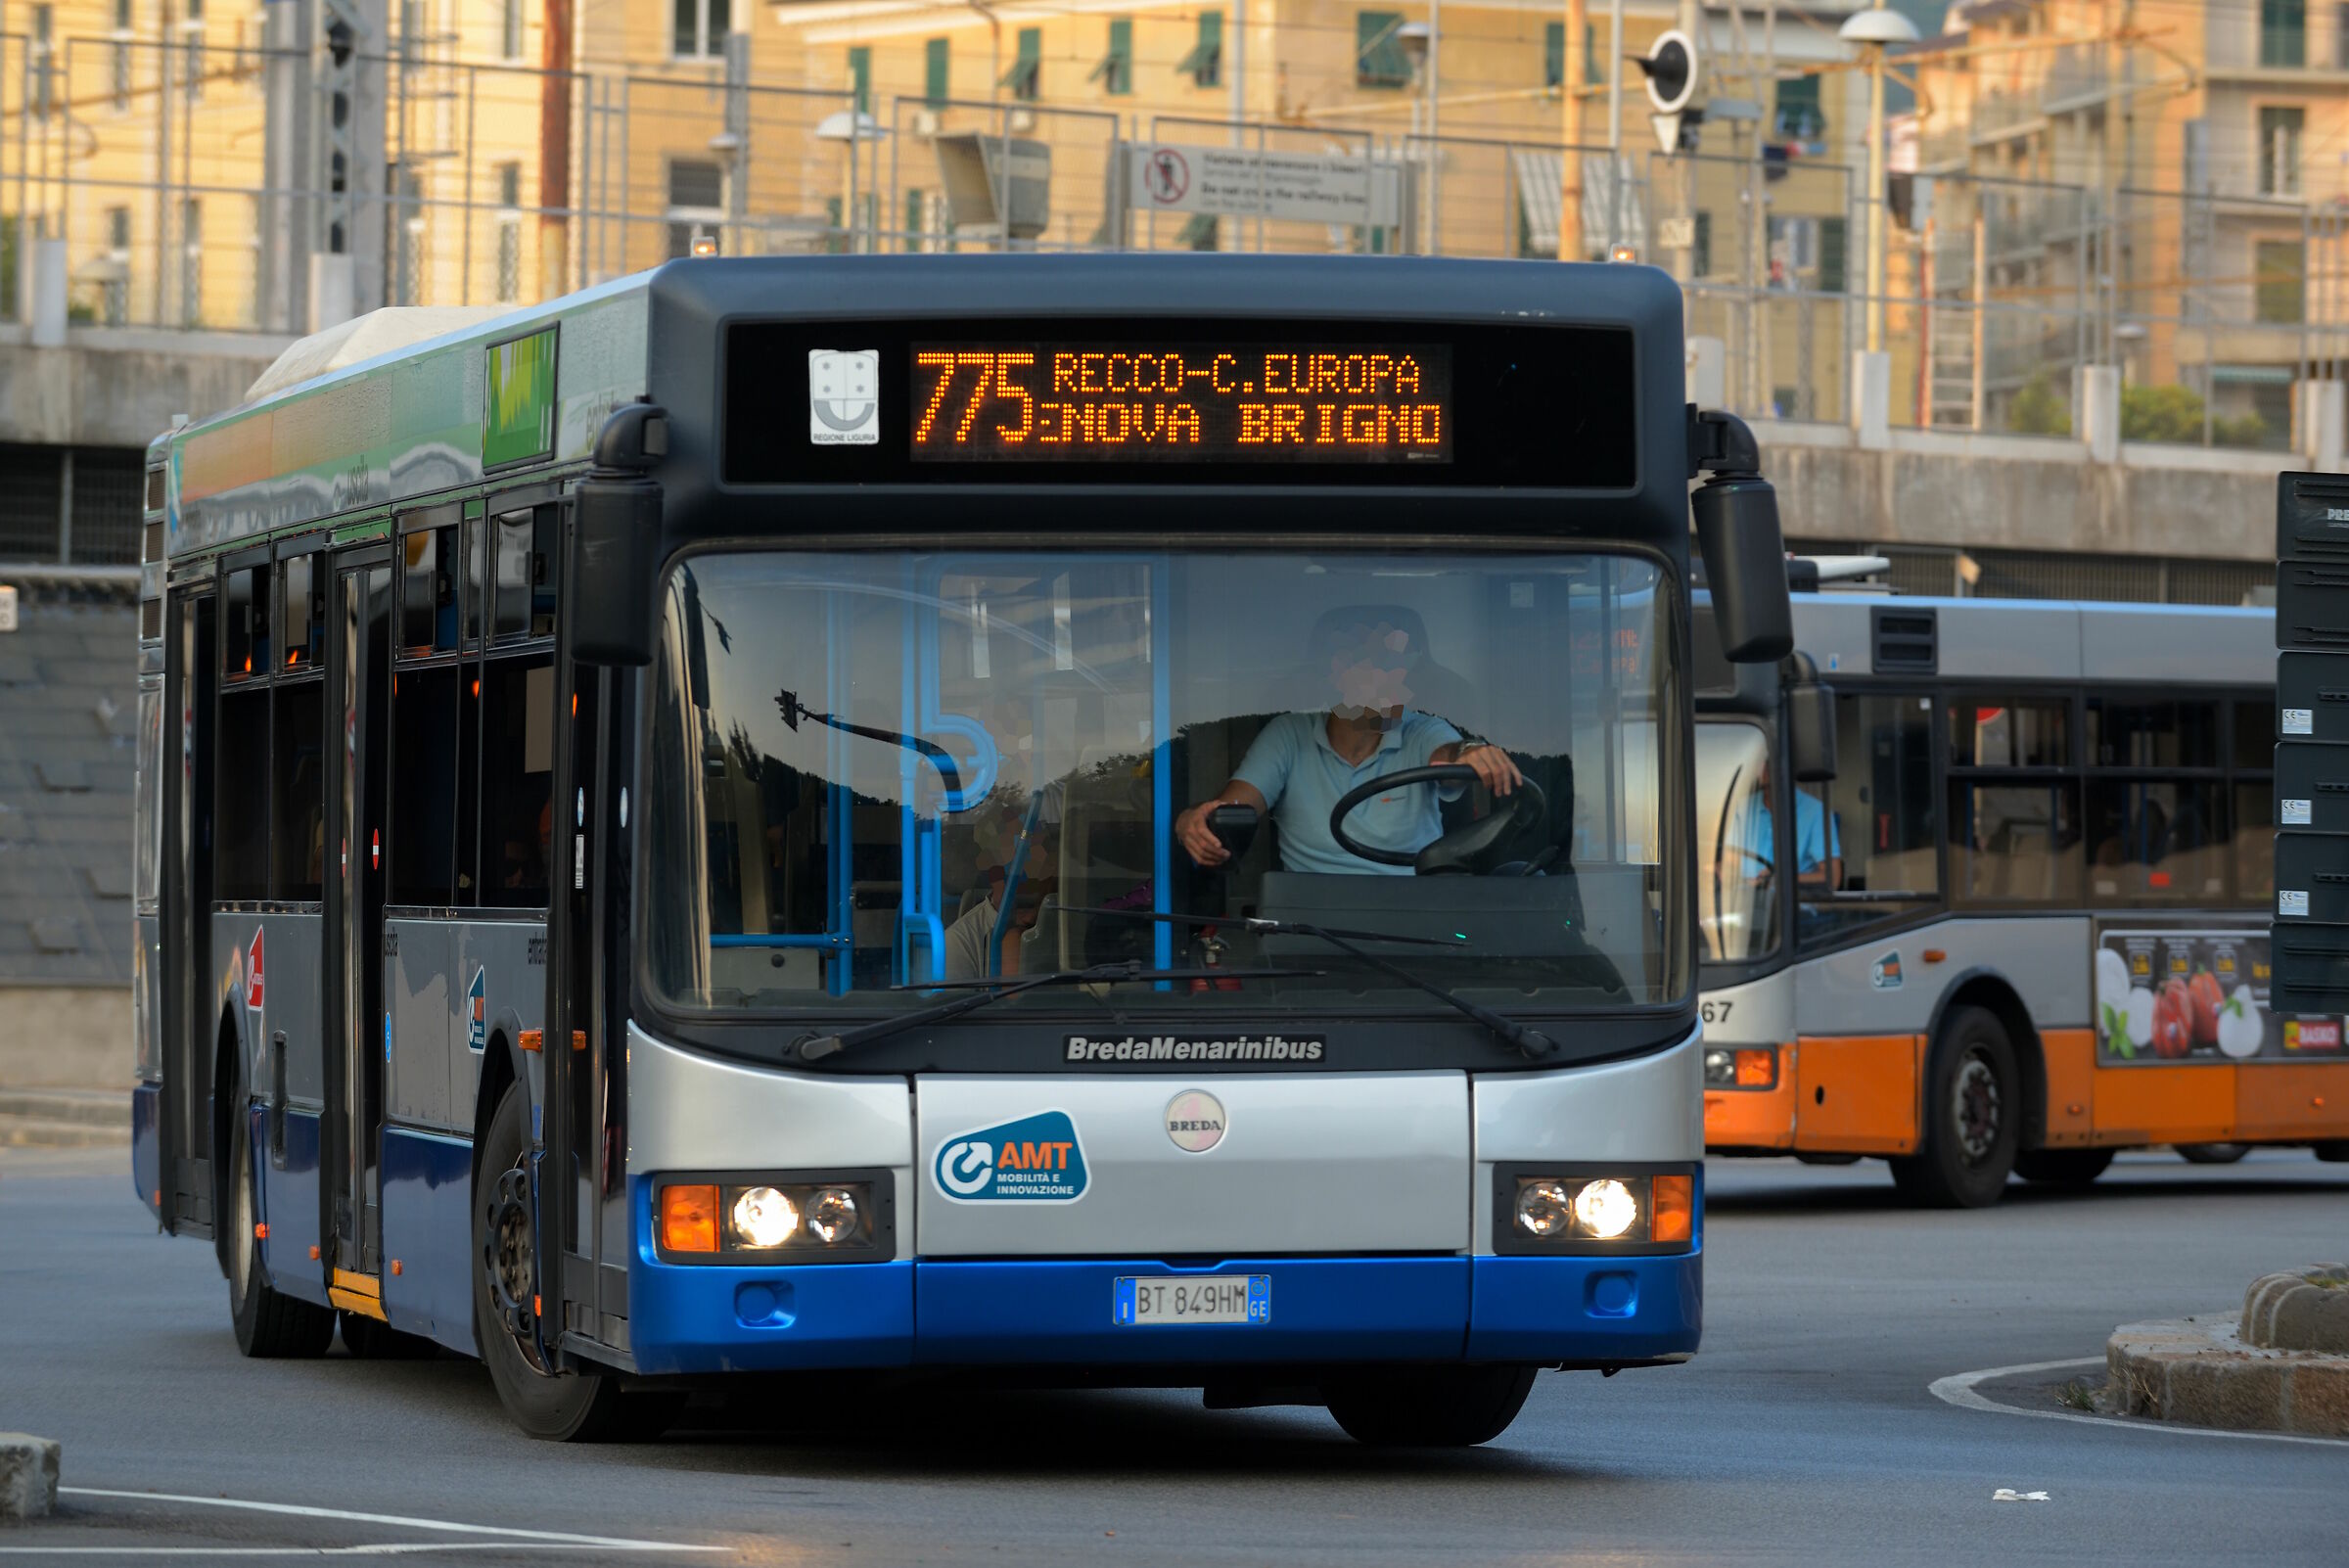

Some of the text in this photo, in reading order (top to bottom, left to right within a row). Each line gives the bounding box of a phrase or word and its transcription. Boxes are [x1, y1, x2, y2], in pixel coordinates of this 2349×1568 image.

[1053, 352, 1420, 394] RECCO-C.EUROPA
[916, 352, 1035, 442] 775
[813, 433, 876, 442] REGIONE LIGURIA
[1067, 1037, 1323, 1061] BredaMenarinibus
[1169, 1120, 1222, 1132] BREDA
[997, 1141, 1073, 1170] AMT
[996, 1172, 1060, 1182] MOBILITÀ E
[996, 1185, 1075, 1195] INNOVAZIONE
[1137, 1285, 1247, 1314] BT 849HM
[1249, 1301, 1267, 1317] GE
